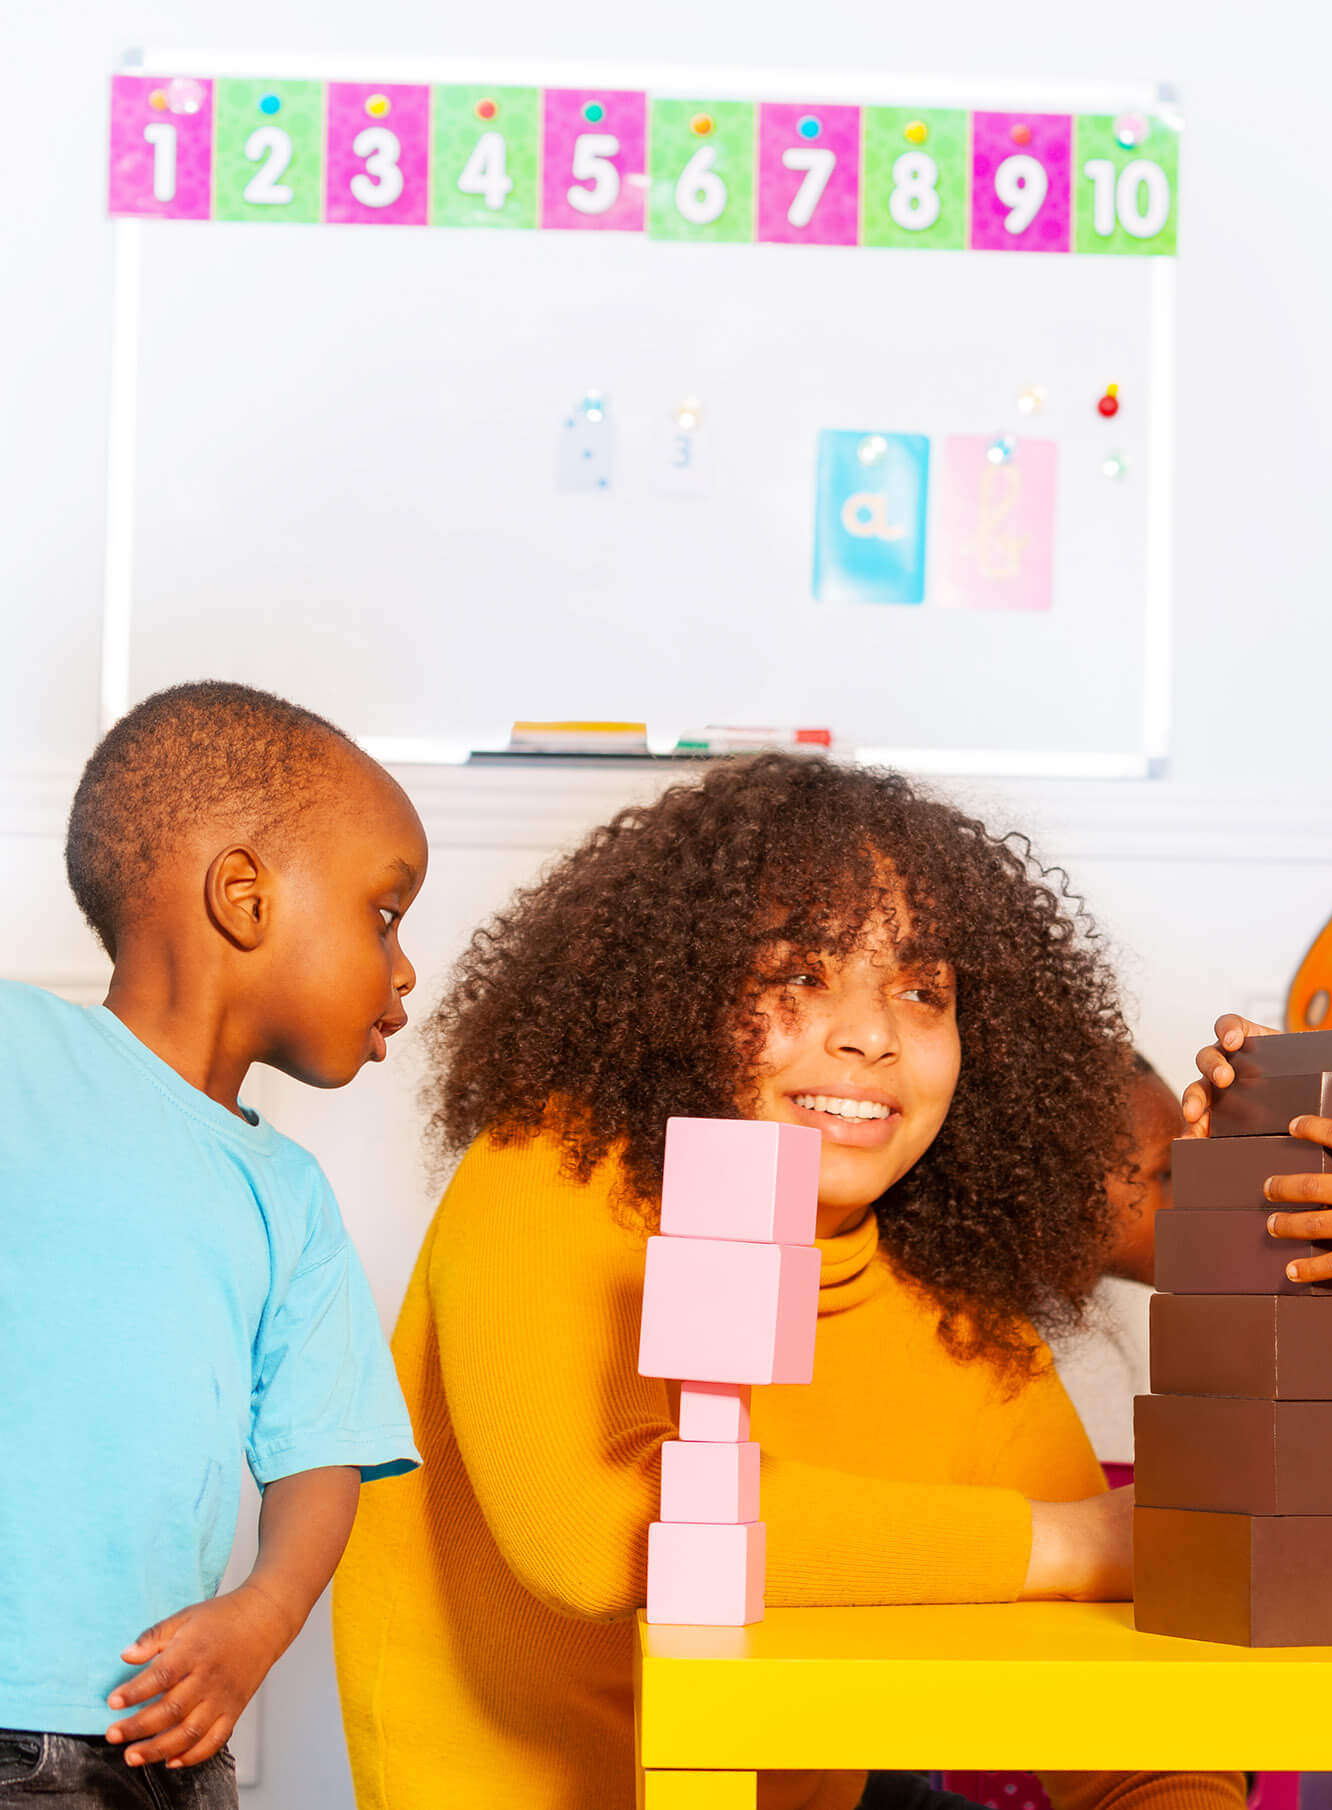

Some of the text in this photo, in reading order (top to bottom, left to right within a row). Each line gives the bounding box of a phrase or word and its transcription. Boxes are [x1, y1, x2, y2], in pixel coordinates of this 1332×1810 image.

[144, 123, 1171, 238] 1 2 3 4 5 6 7 8 9 10
[842, 492, 904, 540] a
